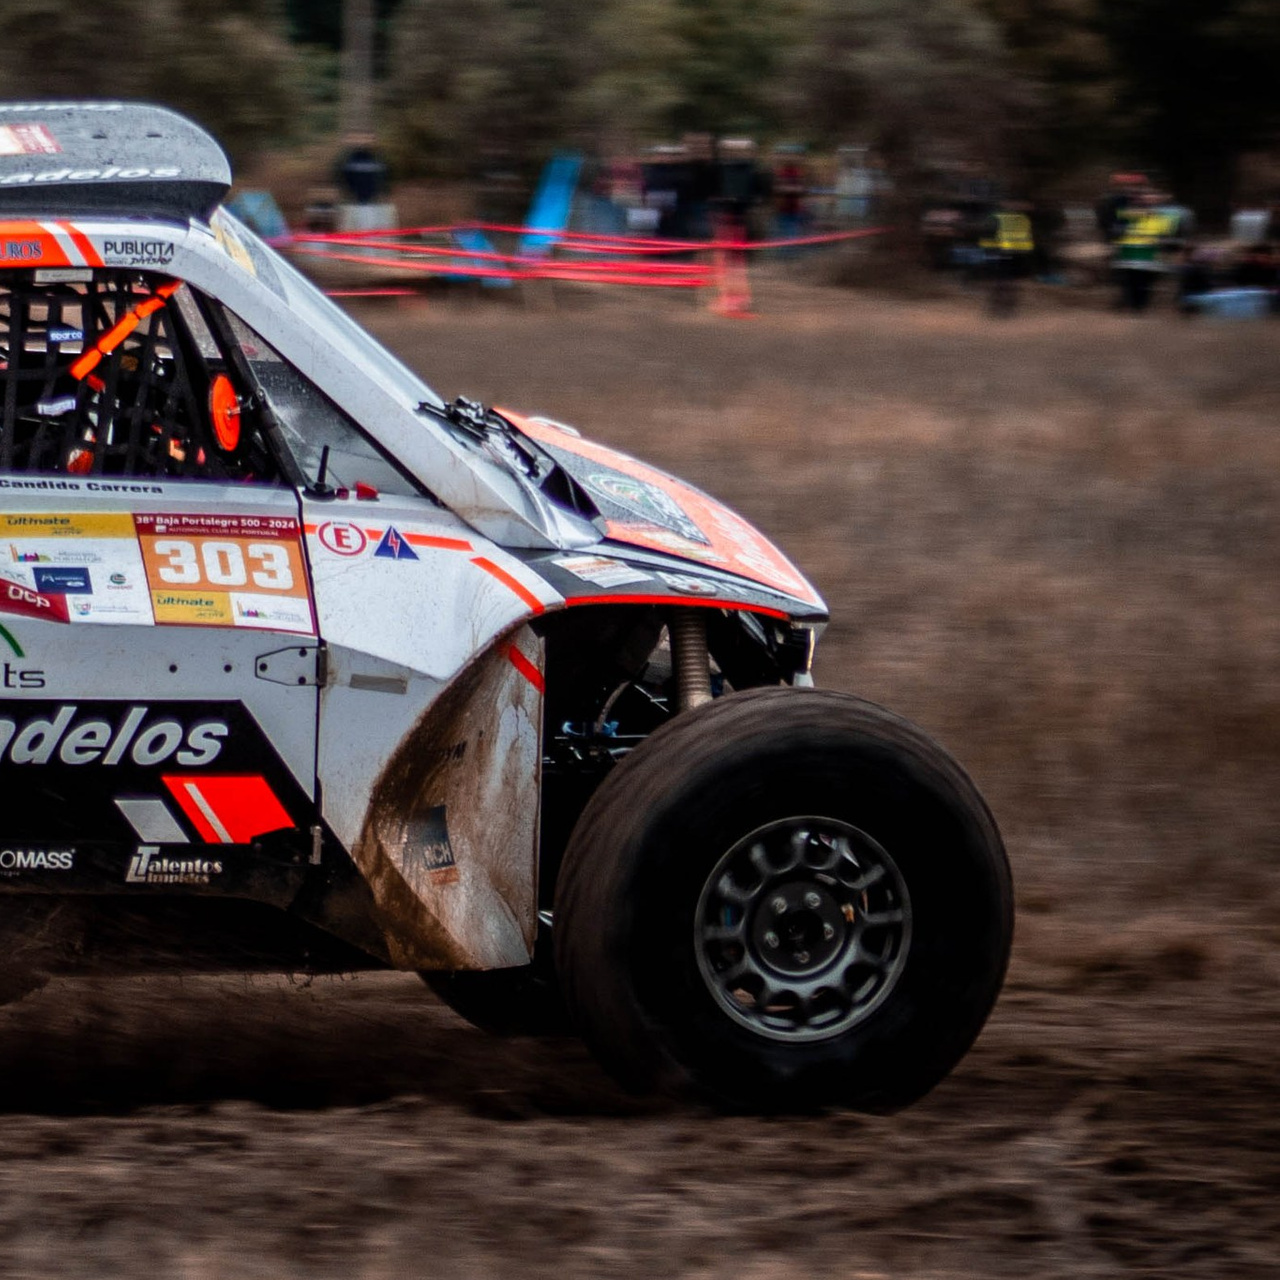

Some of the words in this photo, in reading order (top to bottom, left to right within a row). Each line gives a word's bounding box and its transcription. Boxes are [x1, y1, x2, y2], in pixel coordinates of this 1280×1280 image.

[86, 482, 163, 495] Carrera
[156, 517, 180, 526] Baja
[183, 516, 239, 528] Portalegre
[333, 527, 353, 550] E
[154, 540, 294, 590] 303
